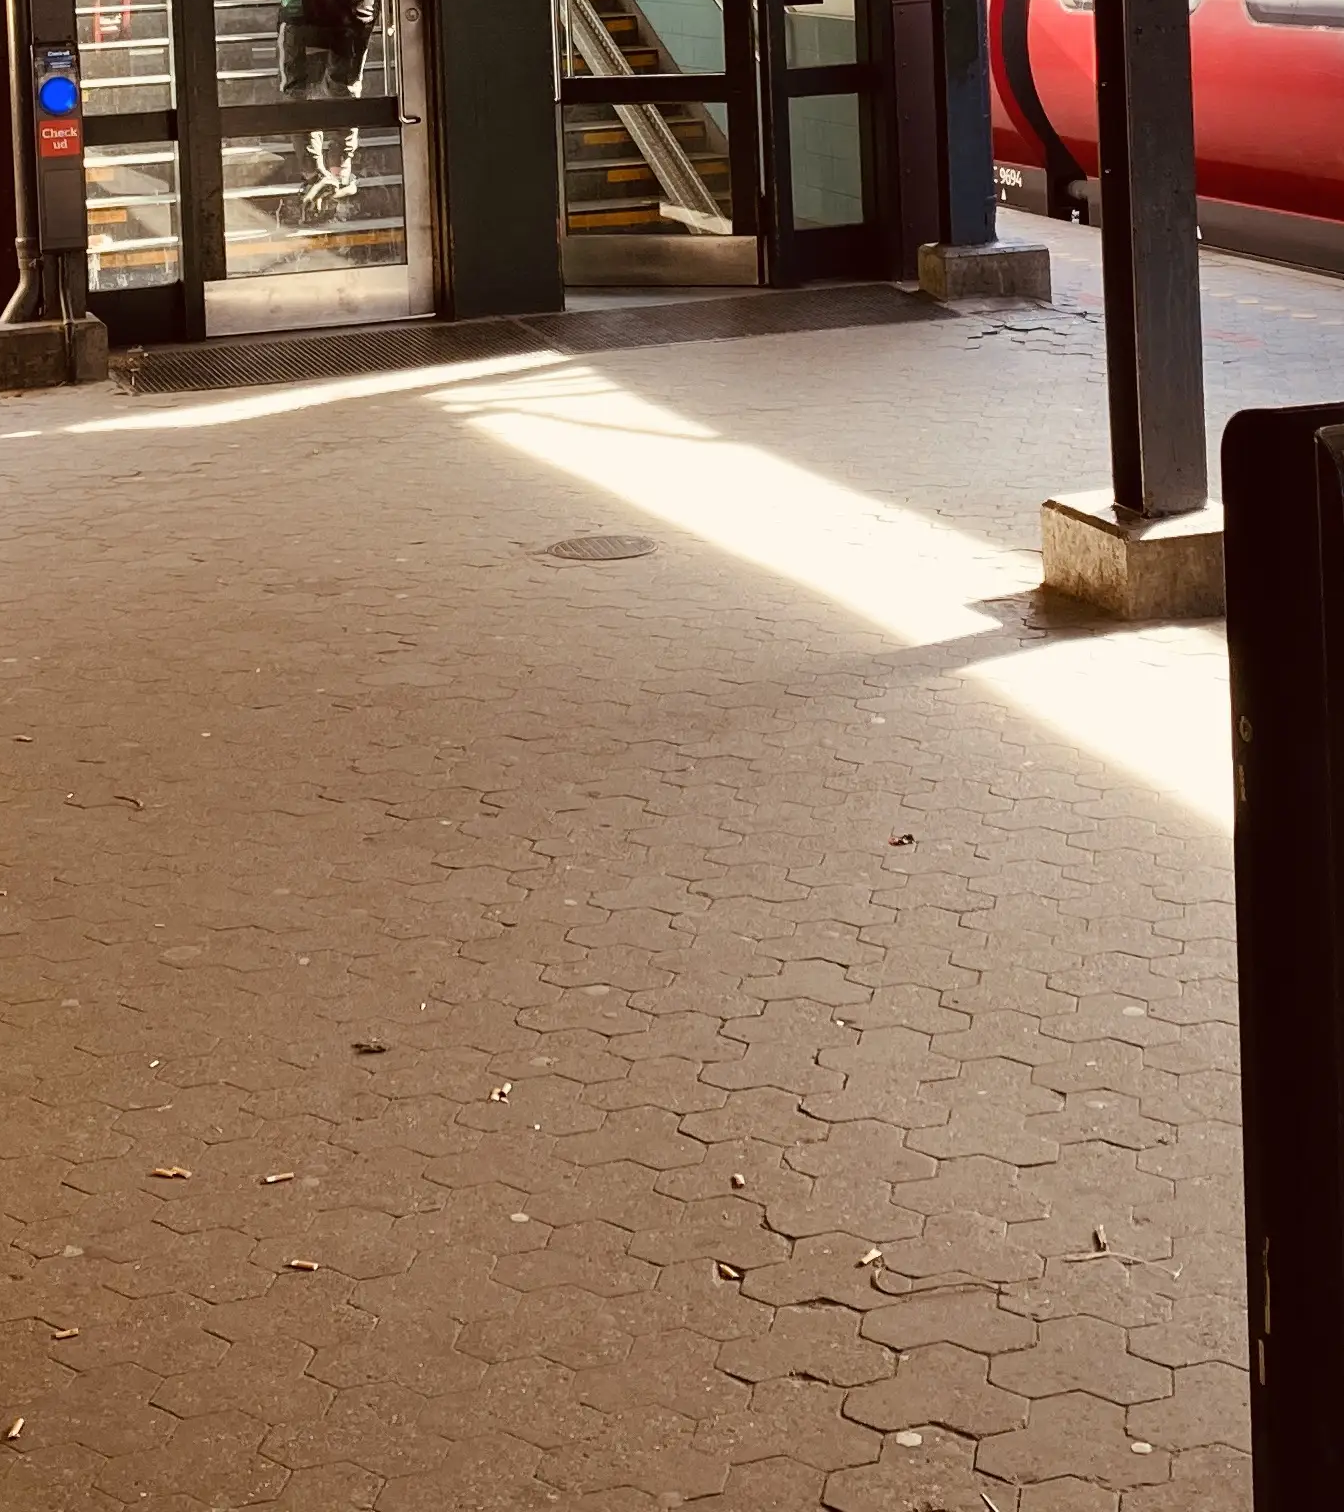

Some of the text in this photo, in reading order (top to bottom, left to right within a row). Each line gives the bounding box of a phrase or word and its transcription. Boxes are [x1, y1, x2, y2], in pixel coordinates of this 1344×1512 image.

[42, 128, 77, 139] Check
[53, 139, 68, 149] ud
[999, 167, 1022, 188] 9694
